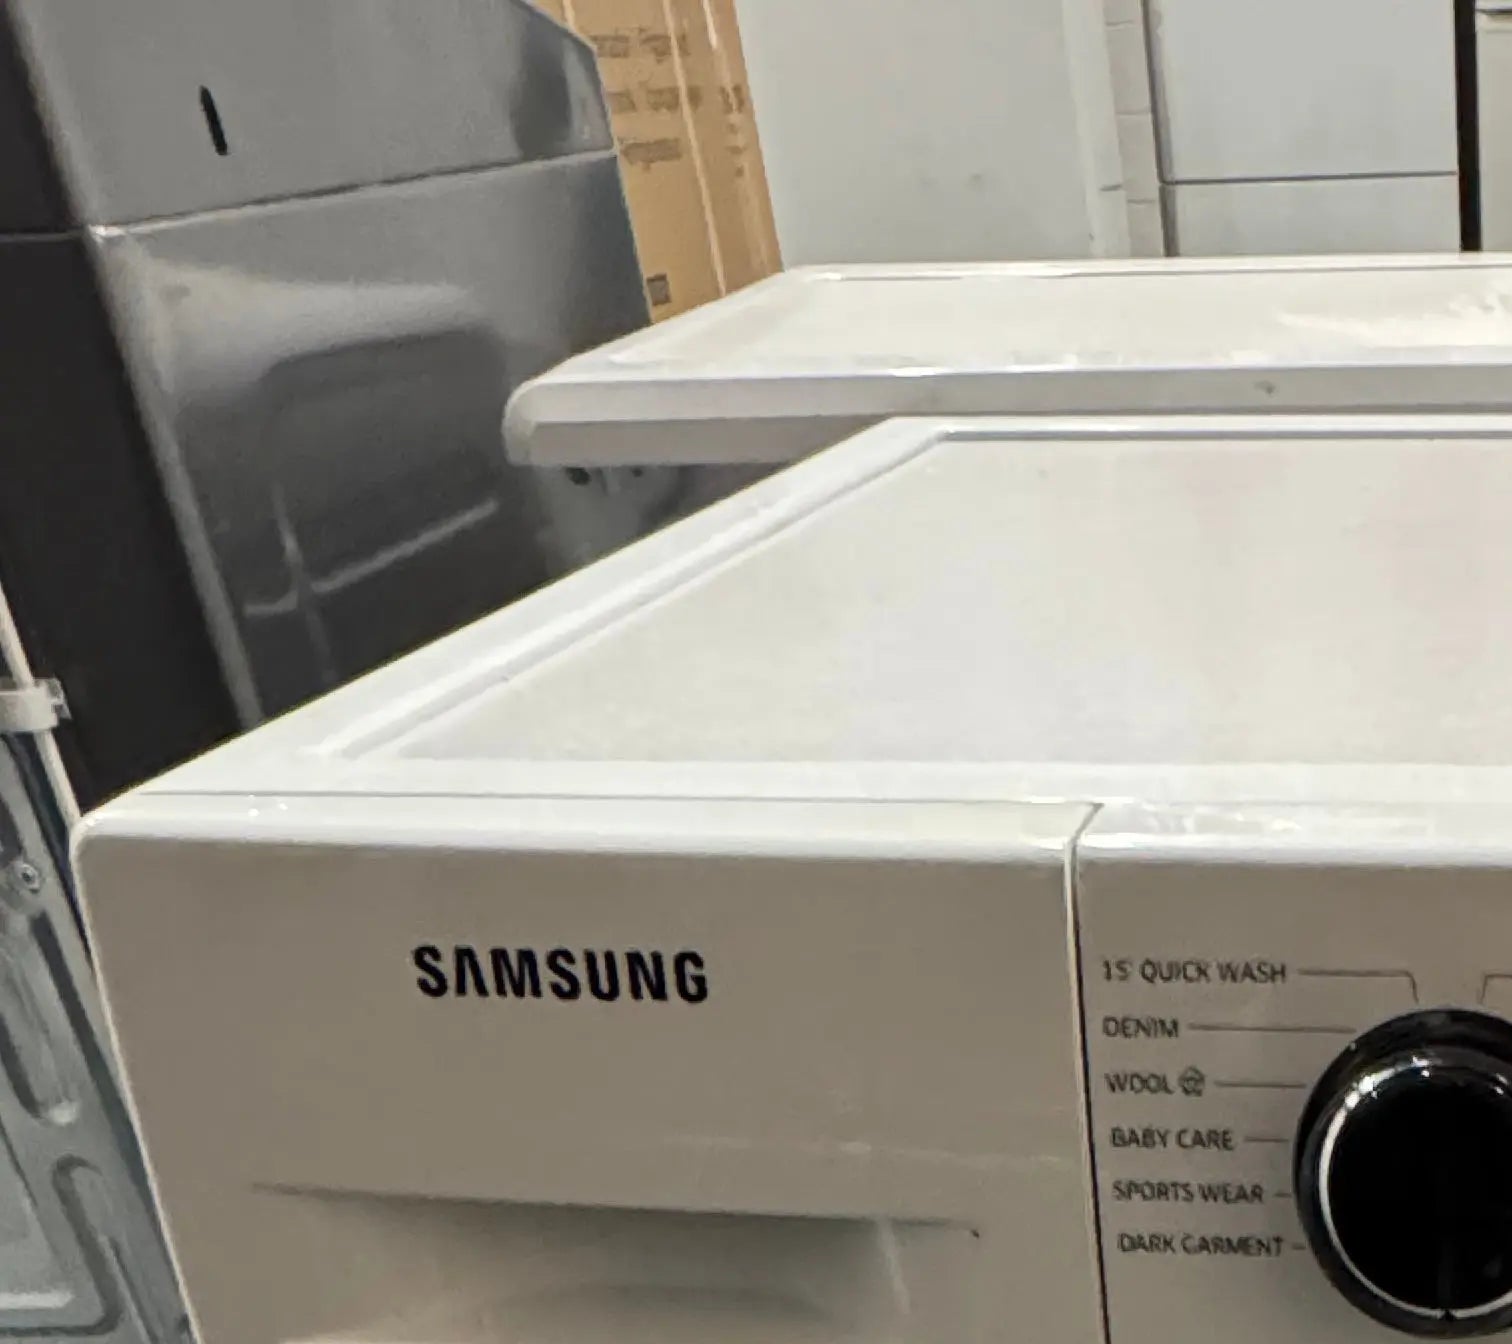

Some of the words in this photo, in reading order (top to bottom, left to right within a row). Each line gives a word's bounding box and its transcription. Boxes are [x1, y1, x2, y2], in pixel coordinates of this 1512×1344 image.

[412, 944, 708, 1004] SAMSUNG
[1140, 958, 1210, 984] QUICK
[1216, 962, 1286, 984] WASH
[1102, 1015, 1179, 1039] DENIM
[1105, 1071, 1174, 1095] WOOL
[1109, 1129, 1169, 1151] BABY
[1176, 1130, 1235, 1151] CARE
[1112, 1181, 1194, 1204] SPORTS
[1200, 1184, 1264, 1204] WEAR
[1117, 1232, 1175, 1256] DARK
[1183, 1233, 1284, 1258] GARMENT
